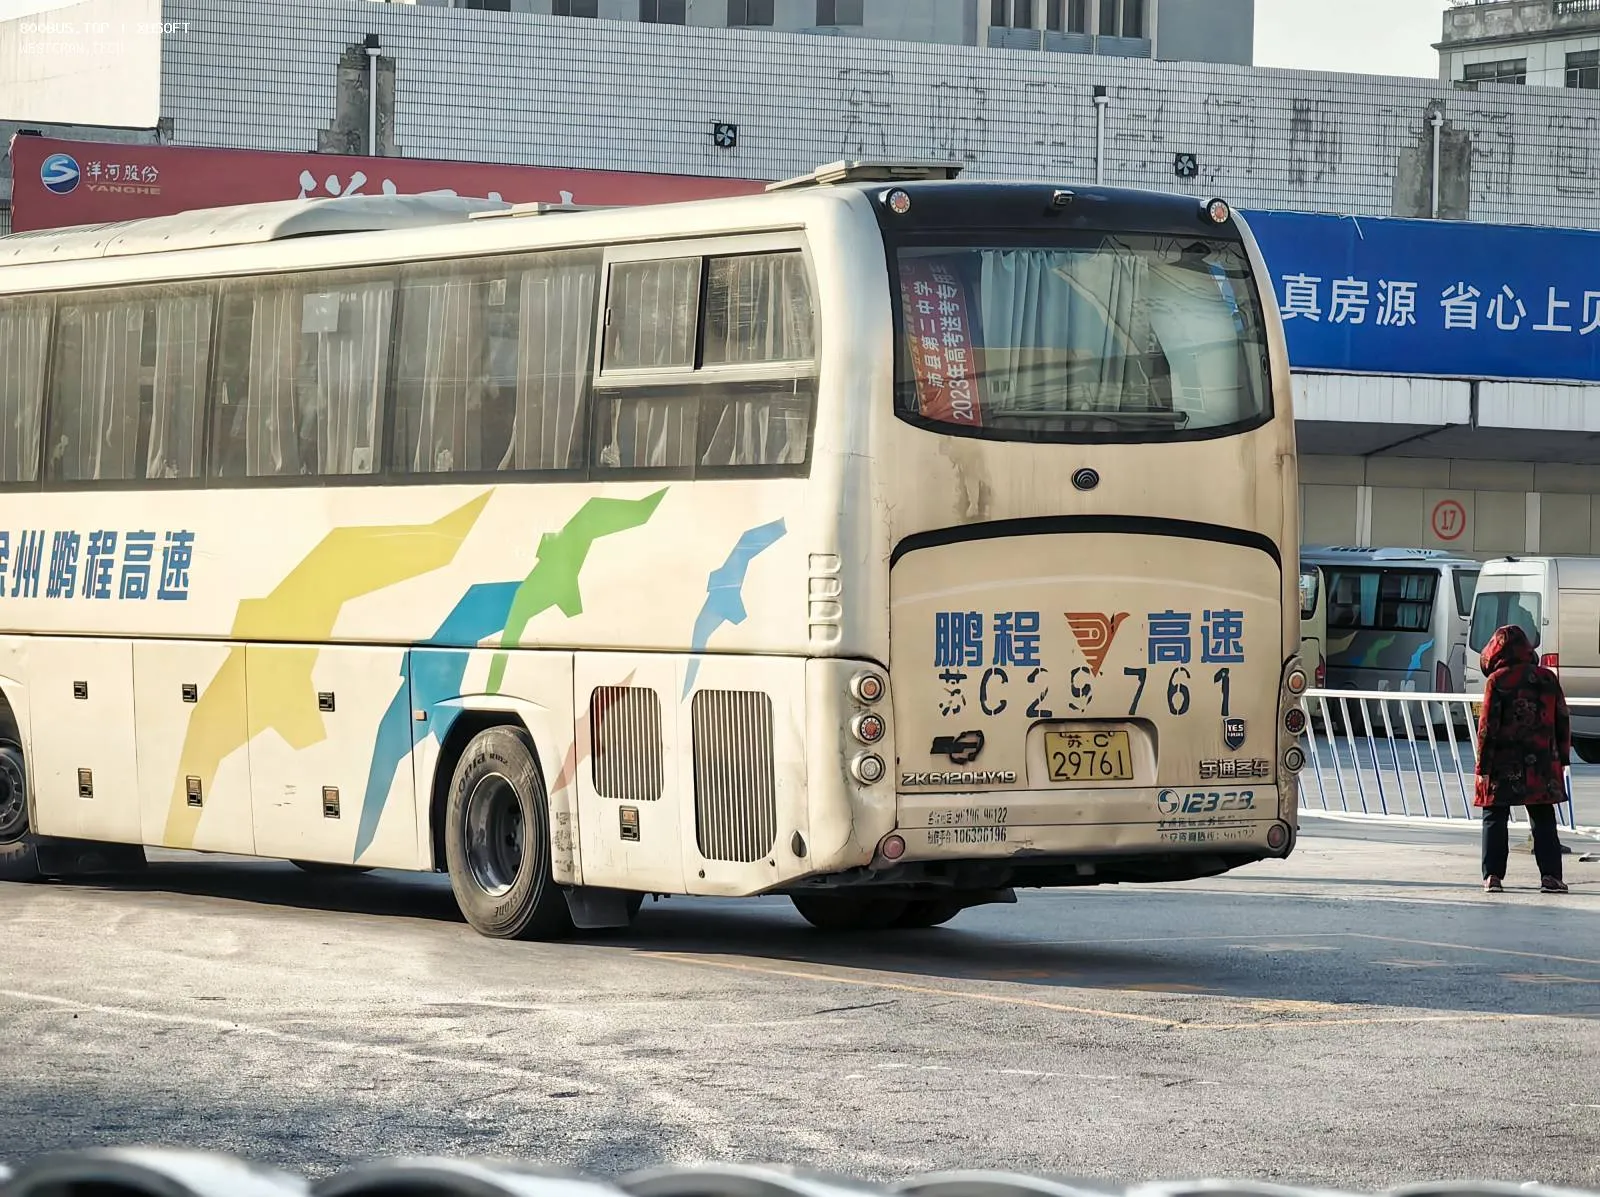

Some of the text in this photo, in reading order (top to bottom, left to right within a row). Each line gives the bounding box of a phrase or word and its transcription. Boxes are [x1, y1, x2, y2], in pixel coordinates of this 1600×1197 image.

[86, 161, 159, 184] 洋河股份
[86, 184, 160, 195] YANGHE
[1281, 274, 1418, 327] 真房源
[913, 281, 945, 389] 沛县第二中学
[1441, 509, 1457, 529] 17
[934, 609, 1245, 667] 鹏程 高速
[1053, 750, 1124, 777] 29761
[1200, 759, 1270, 779] 宇通客车
[901, 771, 1017, 787] ZK6120HY19
